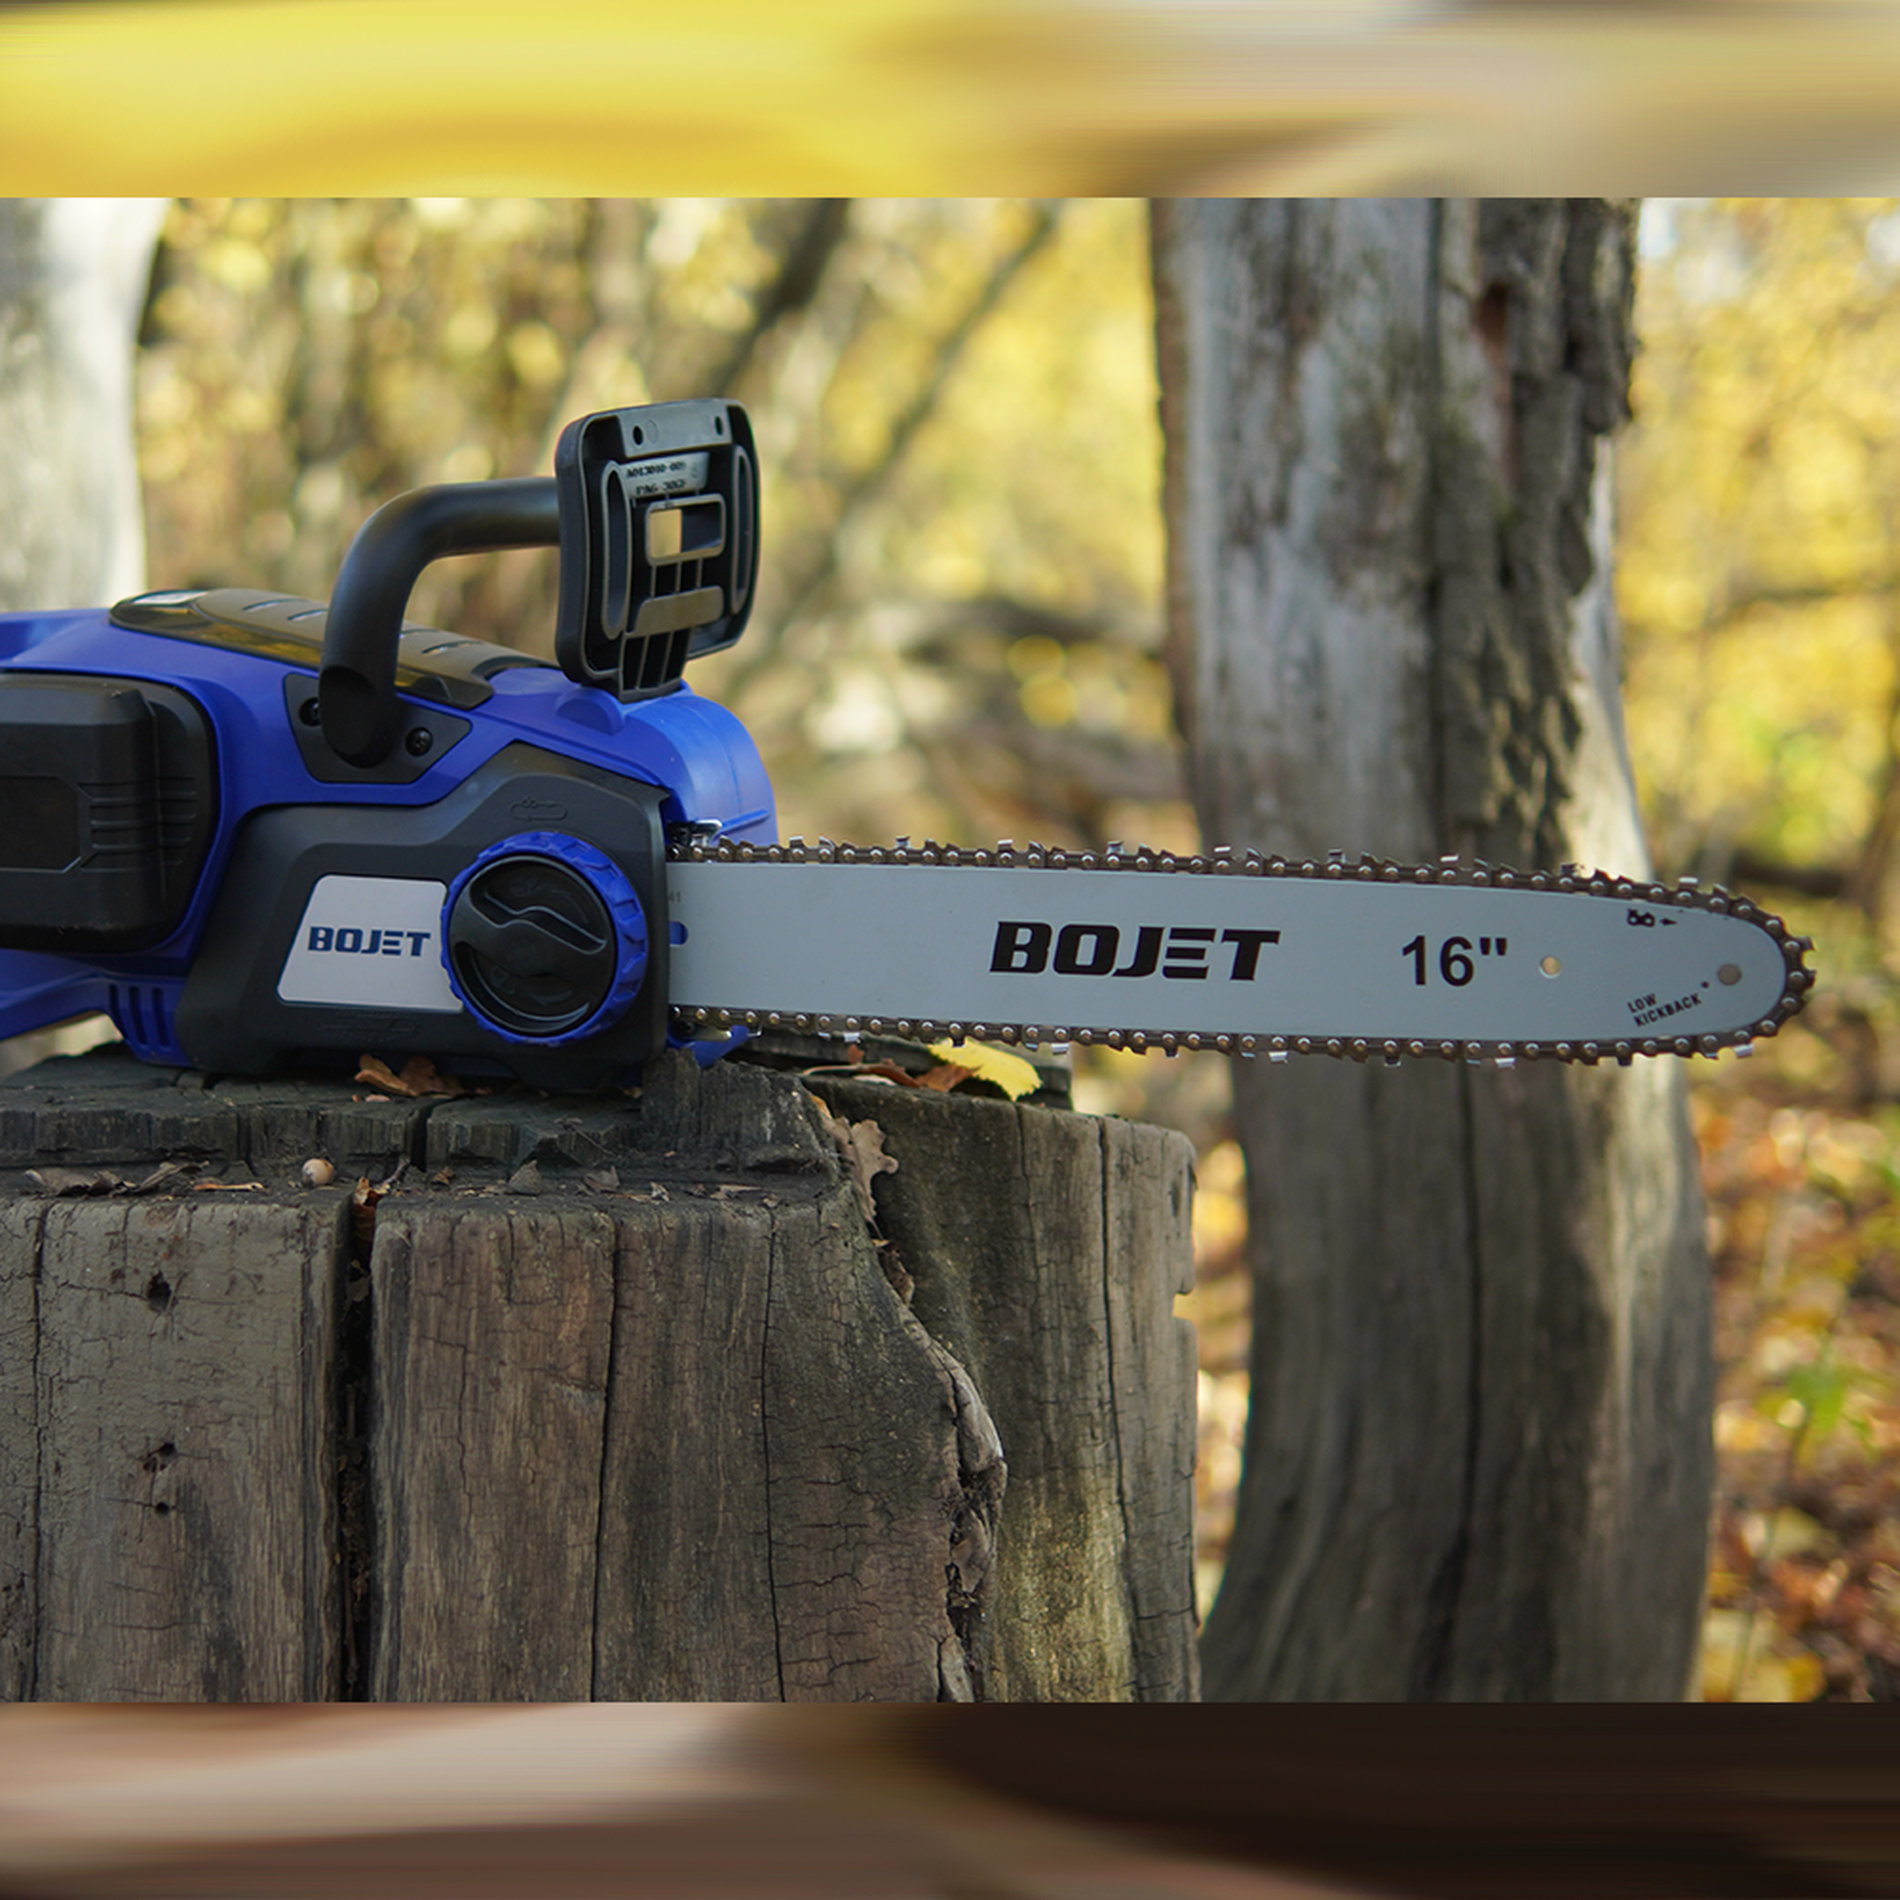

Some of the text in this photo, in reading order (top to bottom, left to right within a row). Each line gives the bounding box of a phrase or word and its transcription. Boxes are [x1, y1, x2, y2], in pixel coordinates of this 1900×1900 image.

[308, 926, 431, 957] BOJET
[990, 921, 1280, 981] BOJET
[1401, 935, 1507, 986] 16"
[1627, 993, 1657, 1013] LOW
[1633, 993, 1702, 1027] KICKBACK
